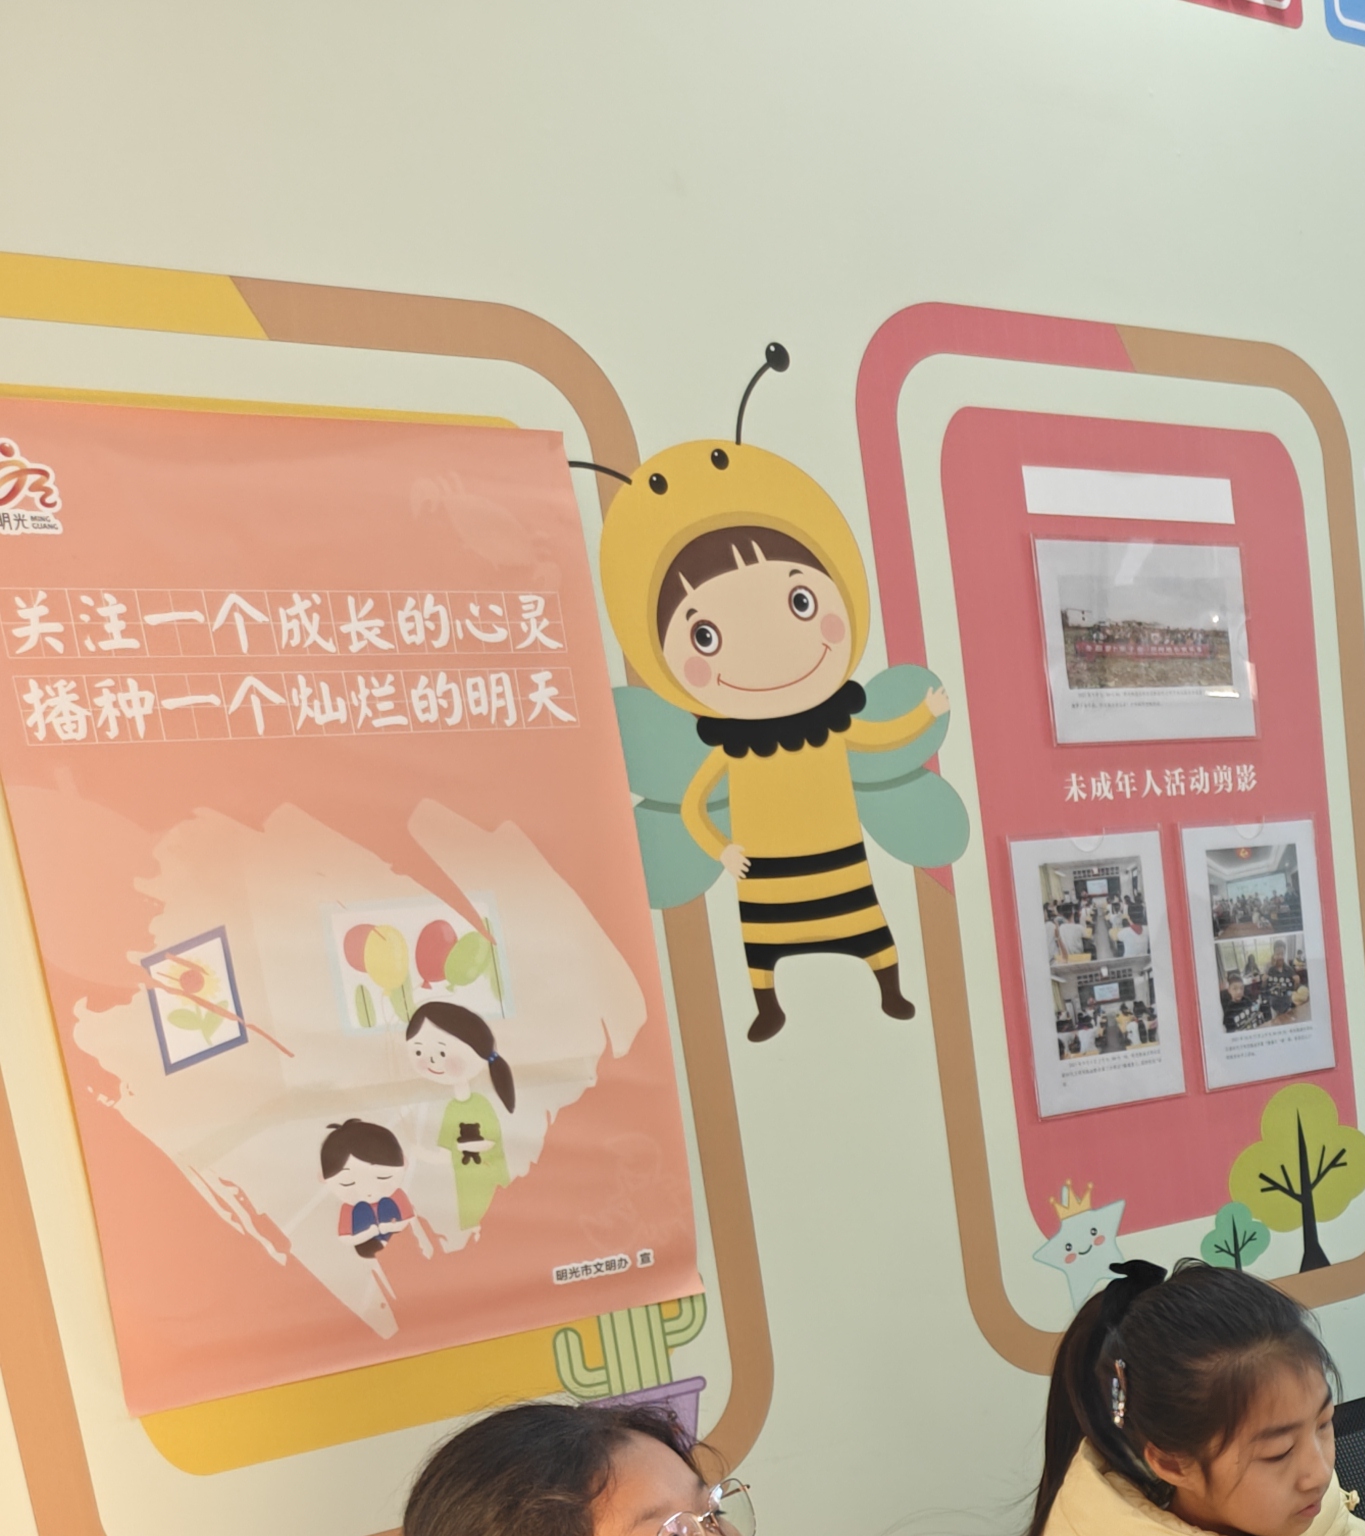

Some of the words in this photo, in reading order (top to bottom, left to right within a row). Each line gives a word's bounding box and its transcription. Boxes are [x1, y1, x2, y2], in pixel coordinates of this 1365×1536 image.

[12, 591, 563, 655] 关注一个成长的心灵
[23, 668, 577, 743] 播种一个灿烂的明天
[1063, 764, 1258, 803] 未成年人活动剪影
[555, 1257, 629, 1281] 明光市文明办
[640, 1252, 651, 1265] 宣
